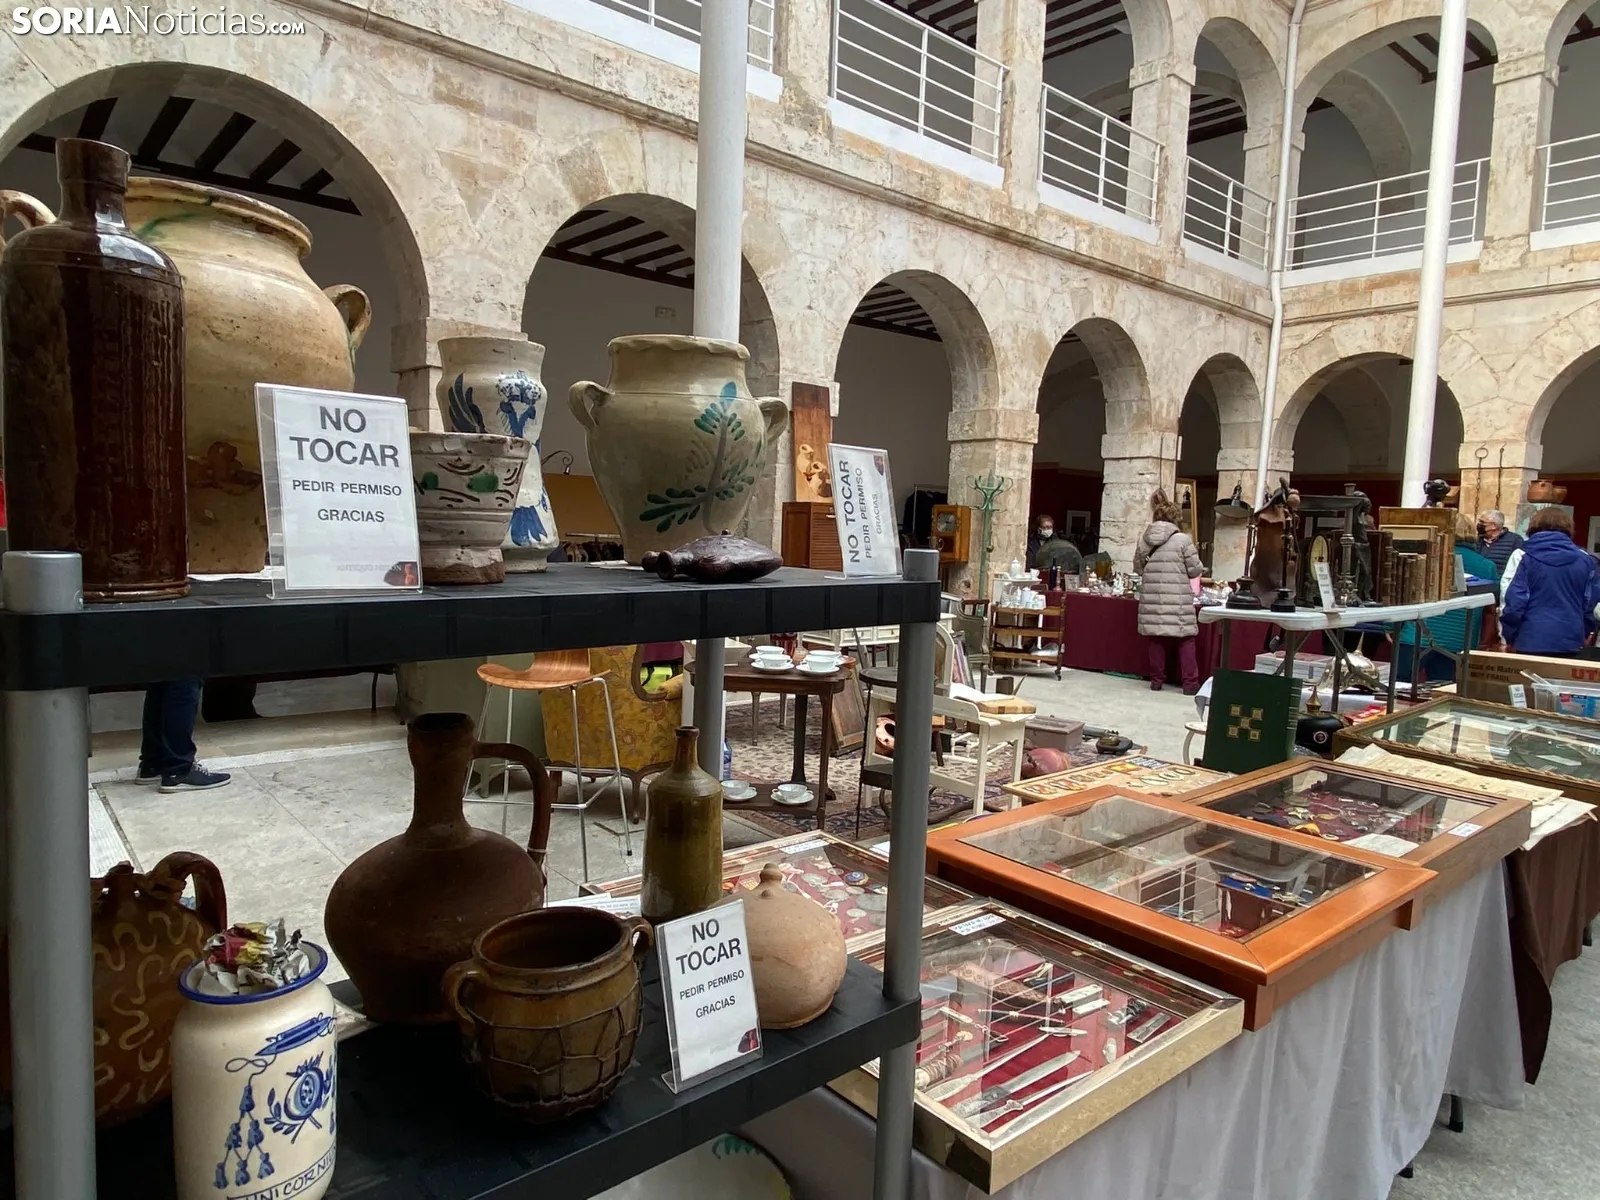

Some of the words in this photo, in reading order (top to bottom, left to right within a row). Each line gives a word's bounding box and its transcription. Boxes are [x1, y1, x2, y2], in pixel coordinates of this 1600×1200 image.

[319, 406, 366, 433] NO
[289, 436, 400, 468] TOCAR
[292, 479, 335, 493] PEDIR
[341, 482, 402, 496] PERMISO
[839, 459, 856, 526] TOCAR
[855, 467, 868, 520] PERMISO
[317, 508, 385, 523] GRACIAS
[872, 493, 883, 535] GRACIAS
[847, 534, 860, 563] NO
[862, 524, 872, 559] PEDIR
[1571, 667, 1600, 682] UT
[691, 918, 720, 944] NO
[675, 937, 742, 975] TOCAR
[679, 983, 705, 1000] PEDIR
[707, 969, 745, 991] PERMISO
[695, 995, 736, 1018] GRACIAS
